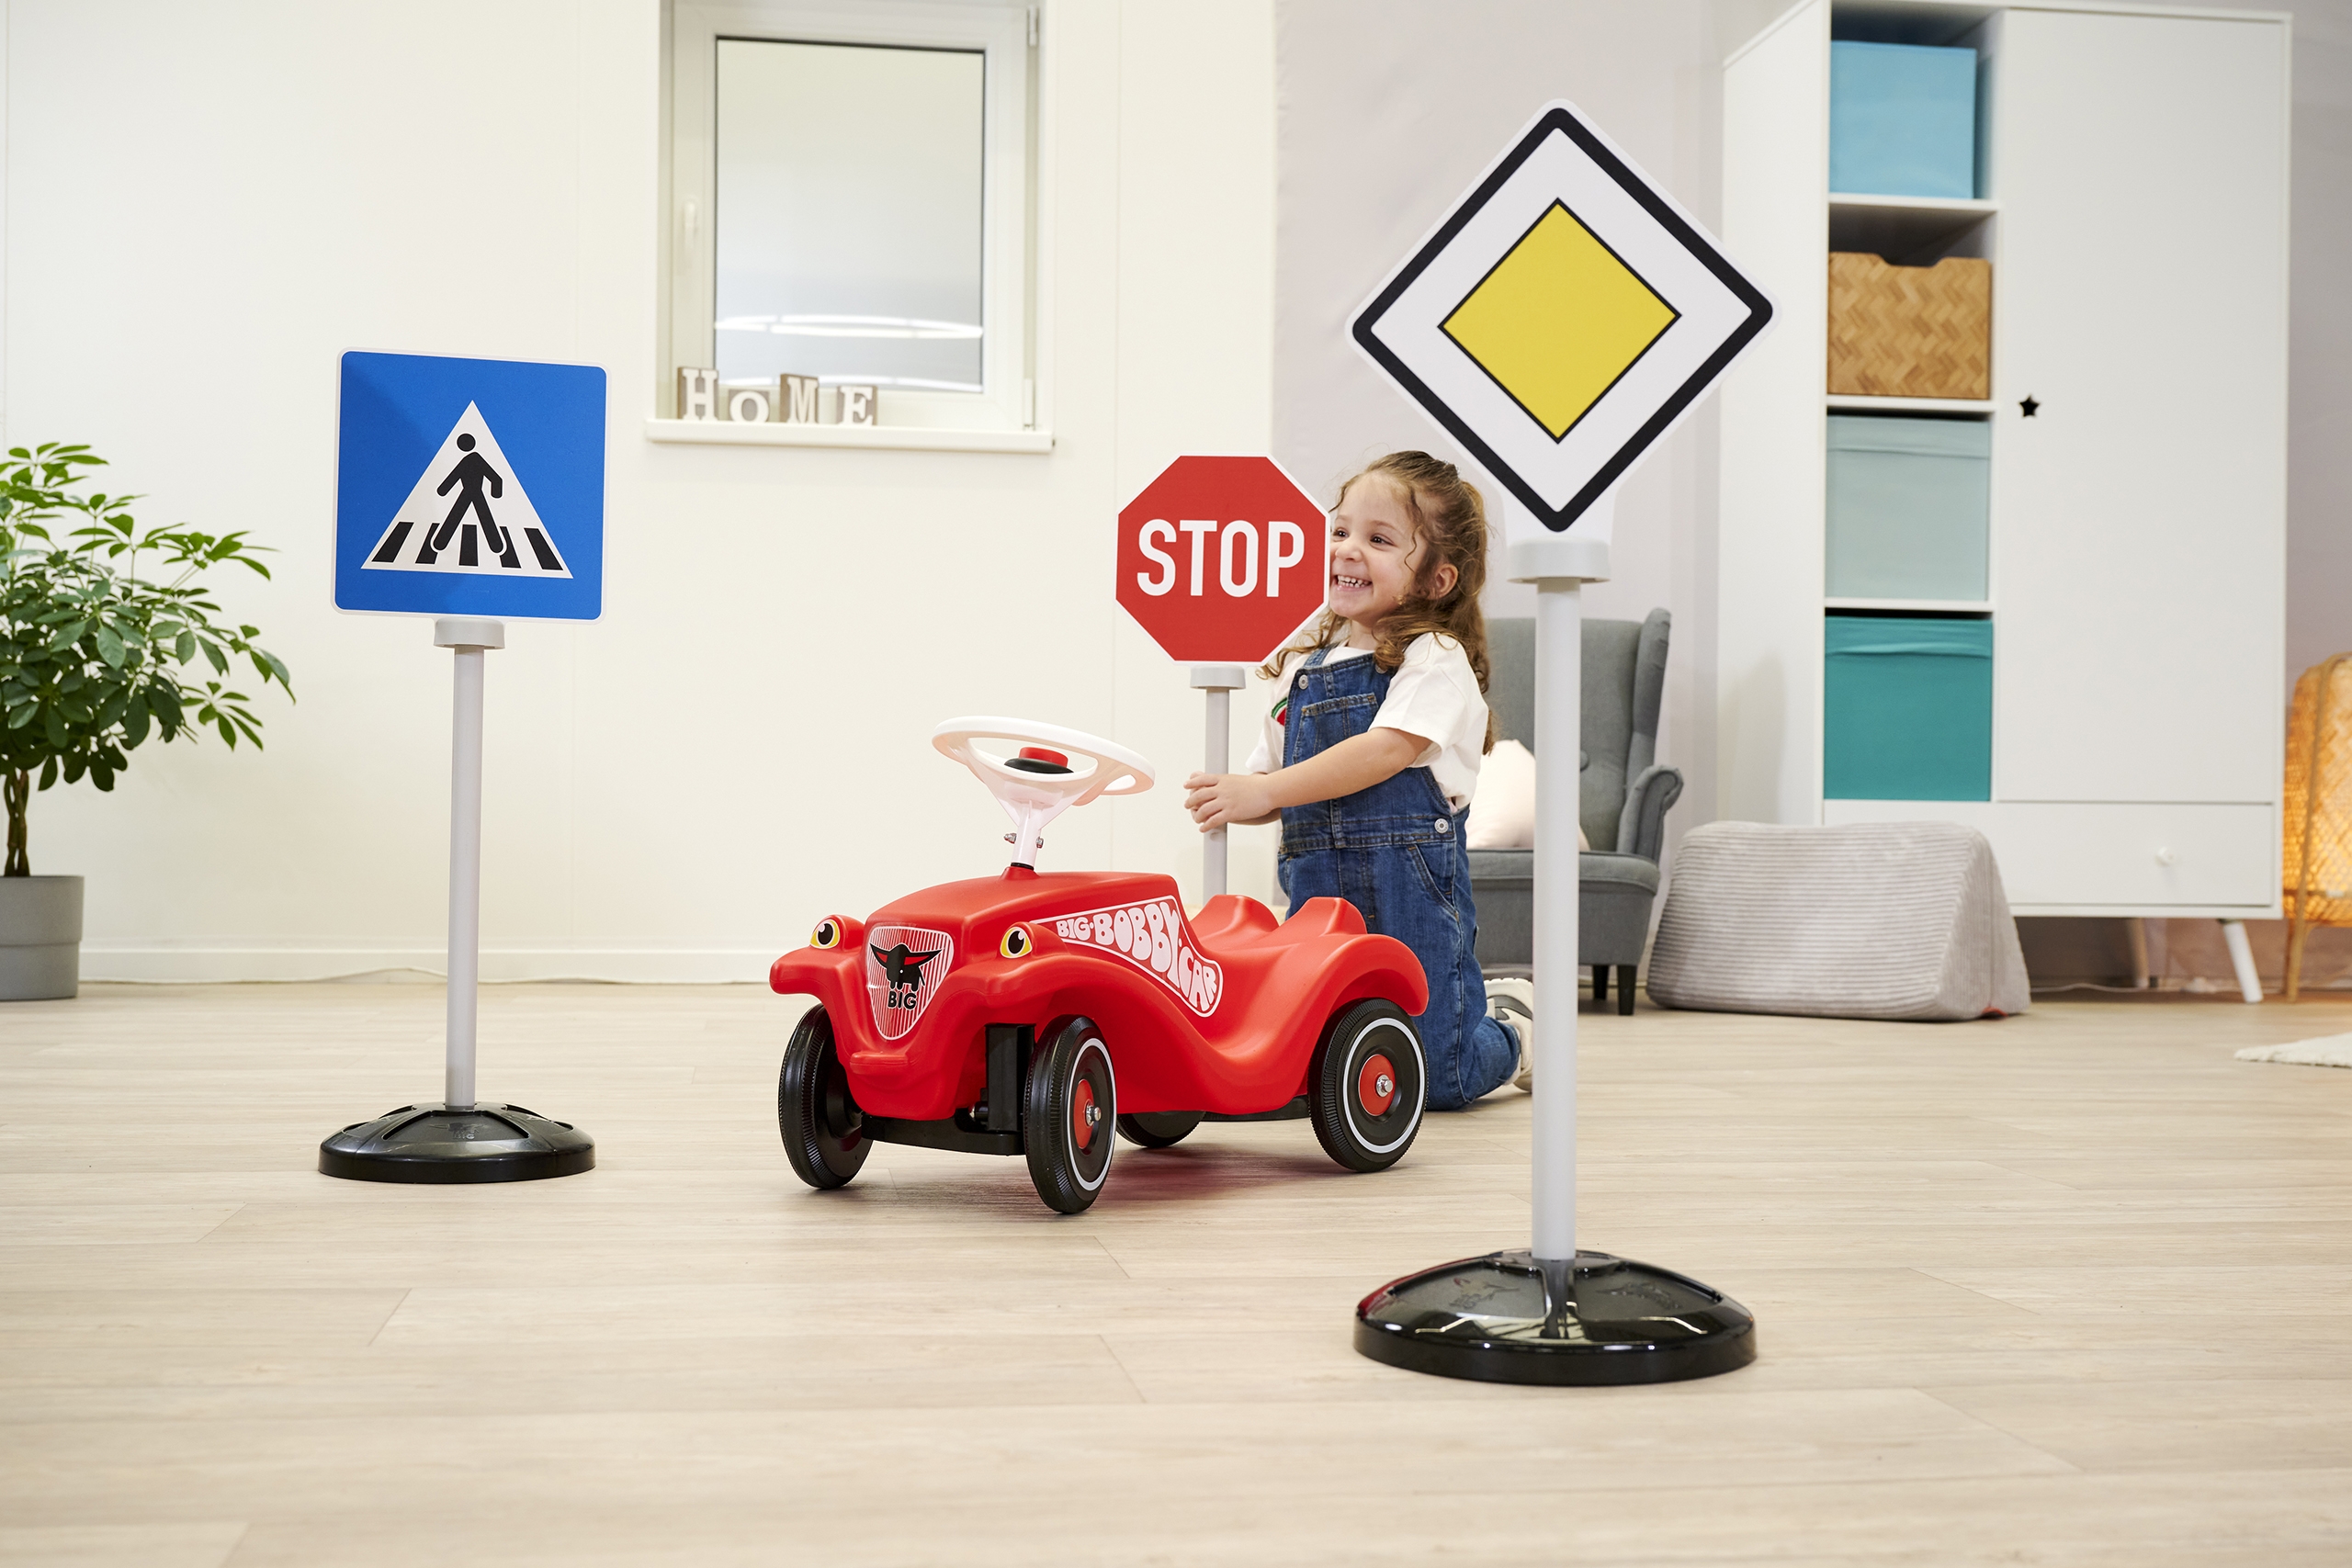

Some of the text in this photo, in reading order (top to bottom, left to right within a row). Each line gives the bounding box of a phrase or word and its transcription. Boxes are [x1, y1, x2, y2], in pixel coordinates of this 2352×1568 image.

[681, 367, 874, 426] HOME
[1136, 518, 1305, 598] STOP
[888, 990, 918, 1010] BIG
